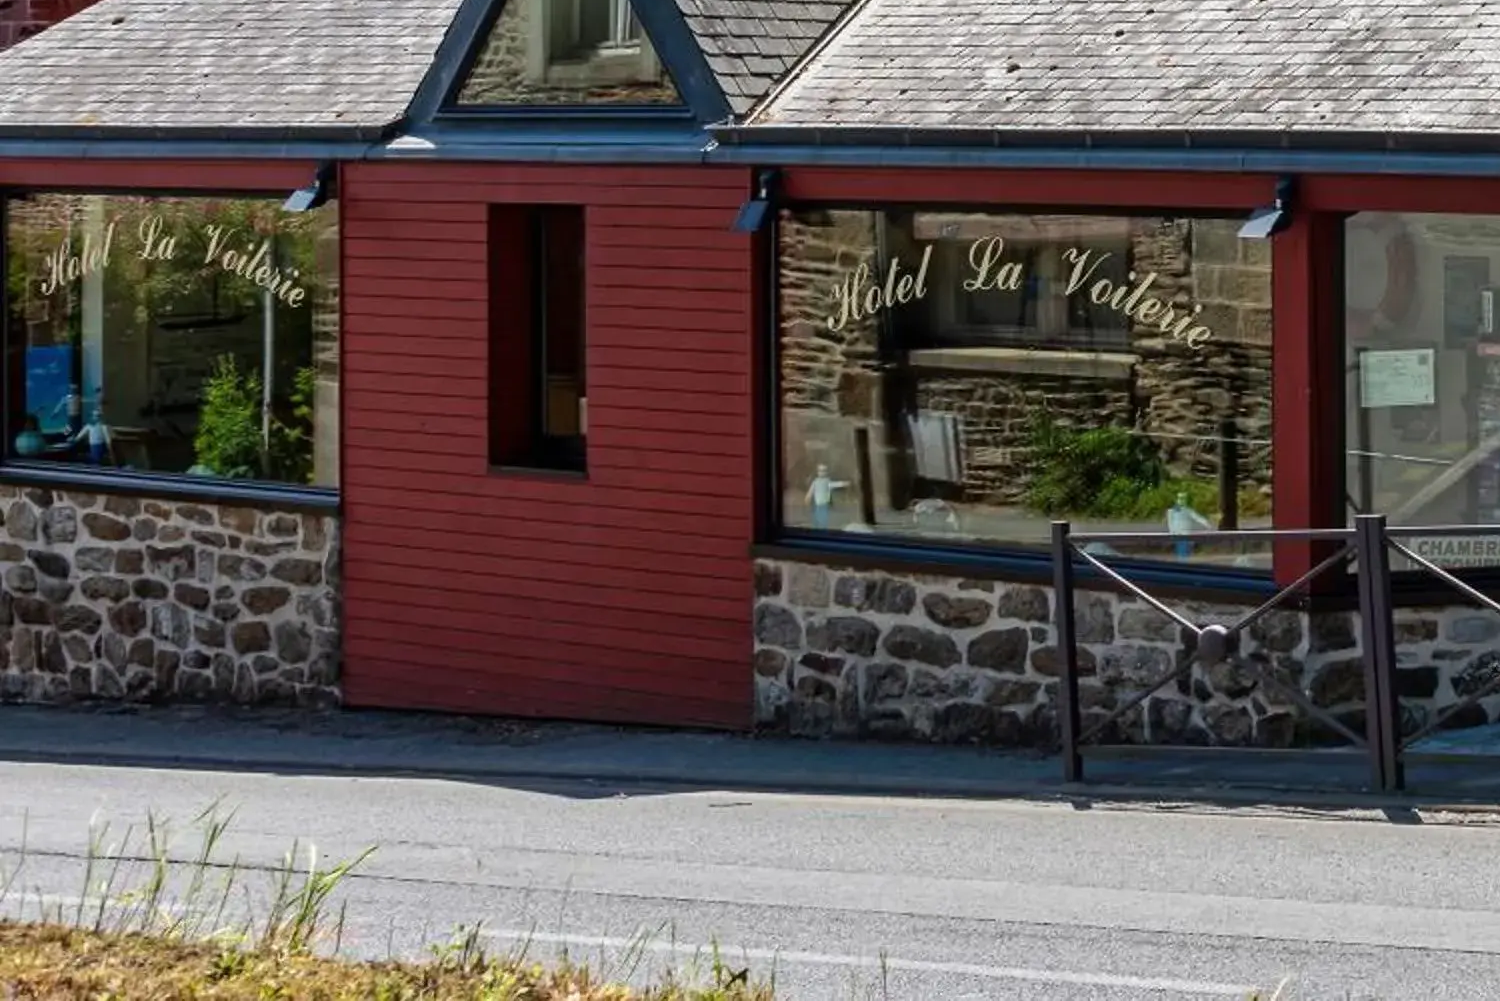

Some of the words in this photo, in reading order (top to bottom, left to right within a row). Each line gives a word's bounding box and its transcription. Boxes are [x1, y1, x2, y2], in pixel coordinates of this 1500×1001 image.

[41, 222, 115, 296] Hotel
[137, 214, 176, 261] La
[203, 224, 305, 308] Voilerie
[827, 244, 933, 332] Hotel
[963, 234, 1023, 293] La
[1061, 247, 1213, 350] Voilerie
